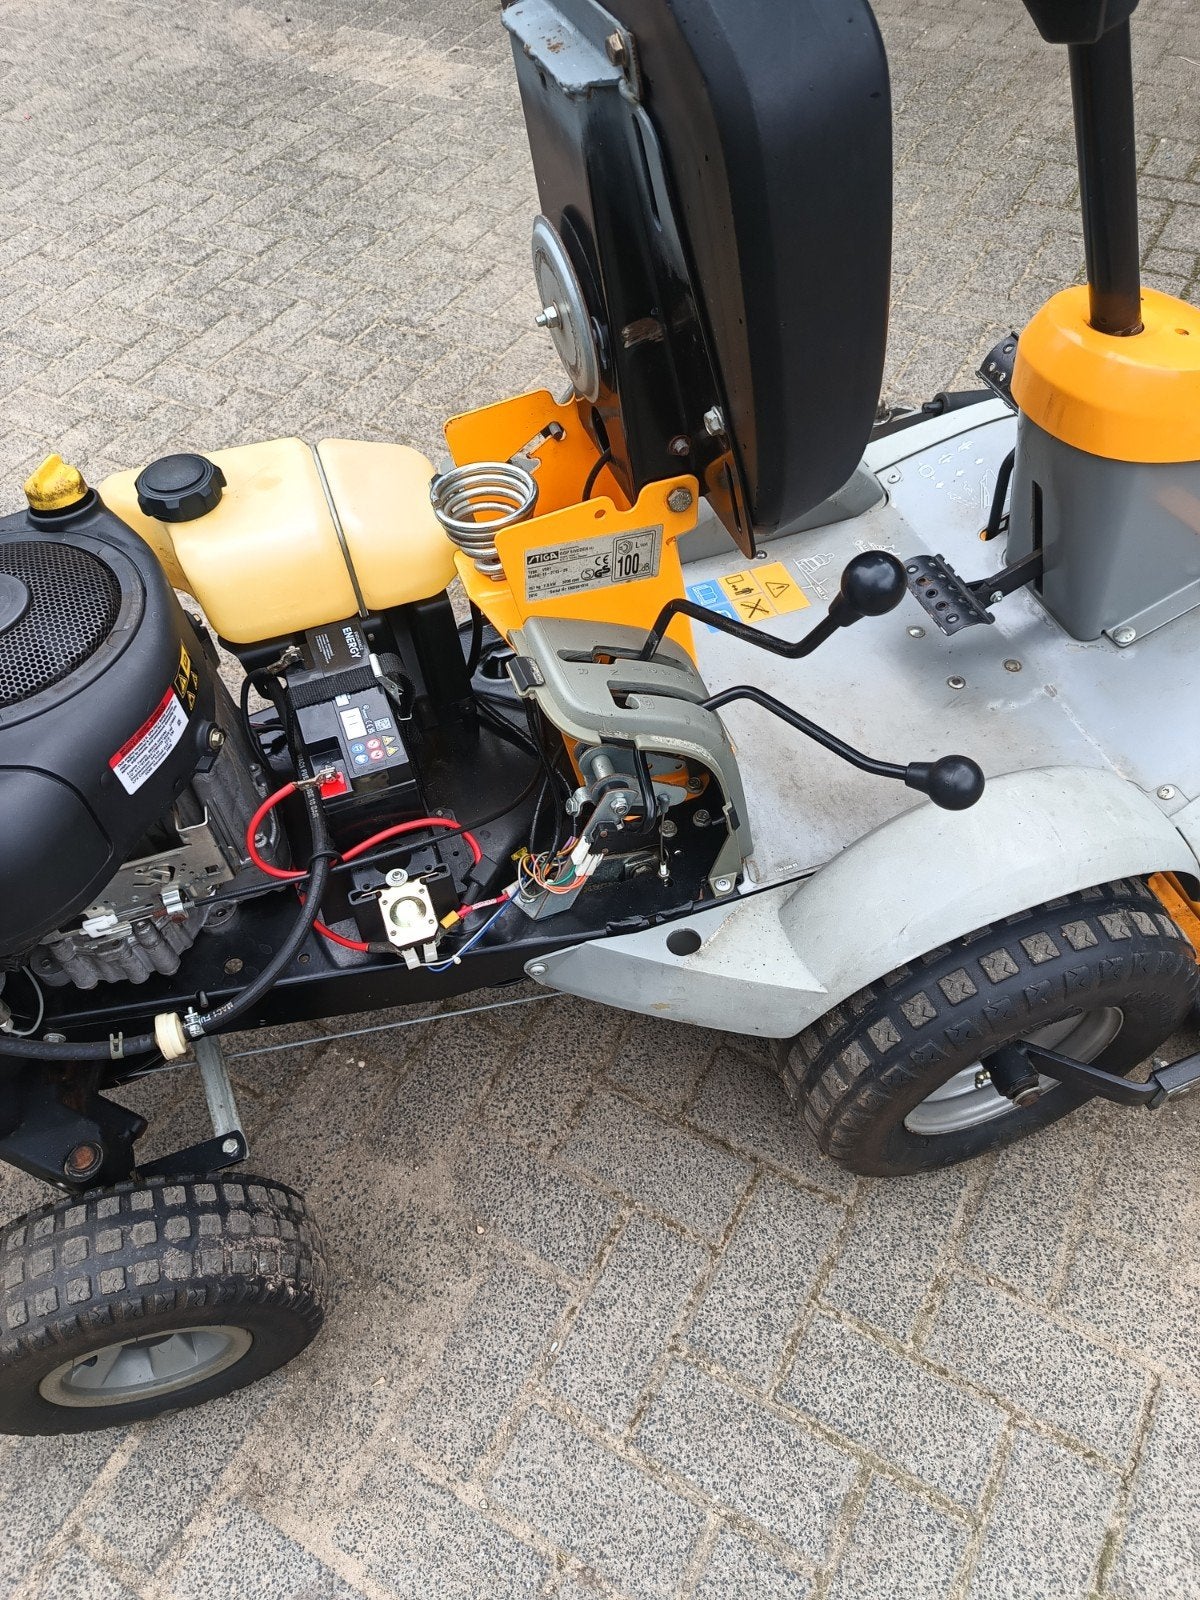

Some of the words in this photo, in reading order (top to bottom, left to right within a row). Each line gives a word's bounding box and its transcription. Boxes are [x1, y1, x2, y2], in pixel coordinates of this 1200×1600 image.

[528, 552, 558, 564] STIGA
[617, 553, 640, 577] 100
[342, 626, 361, 659] ENERGY
